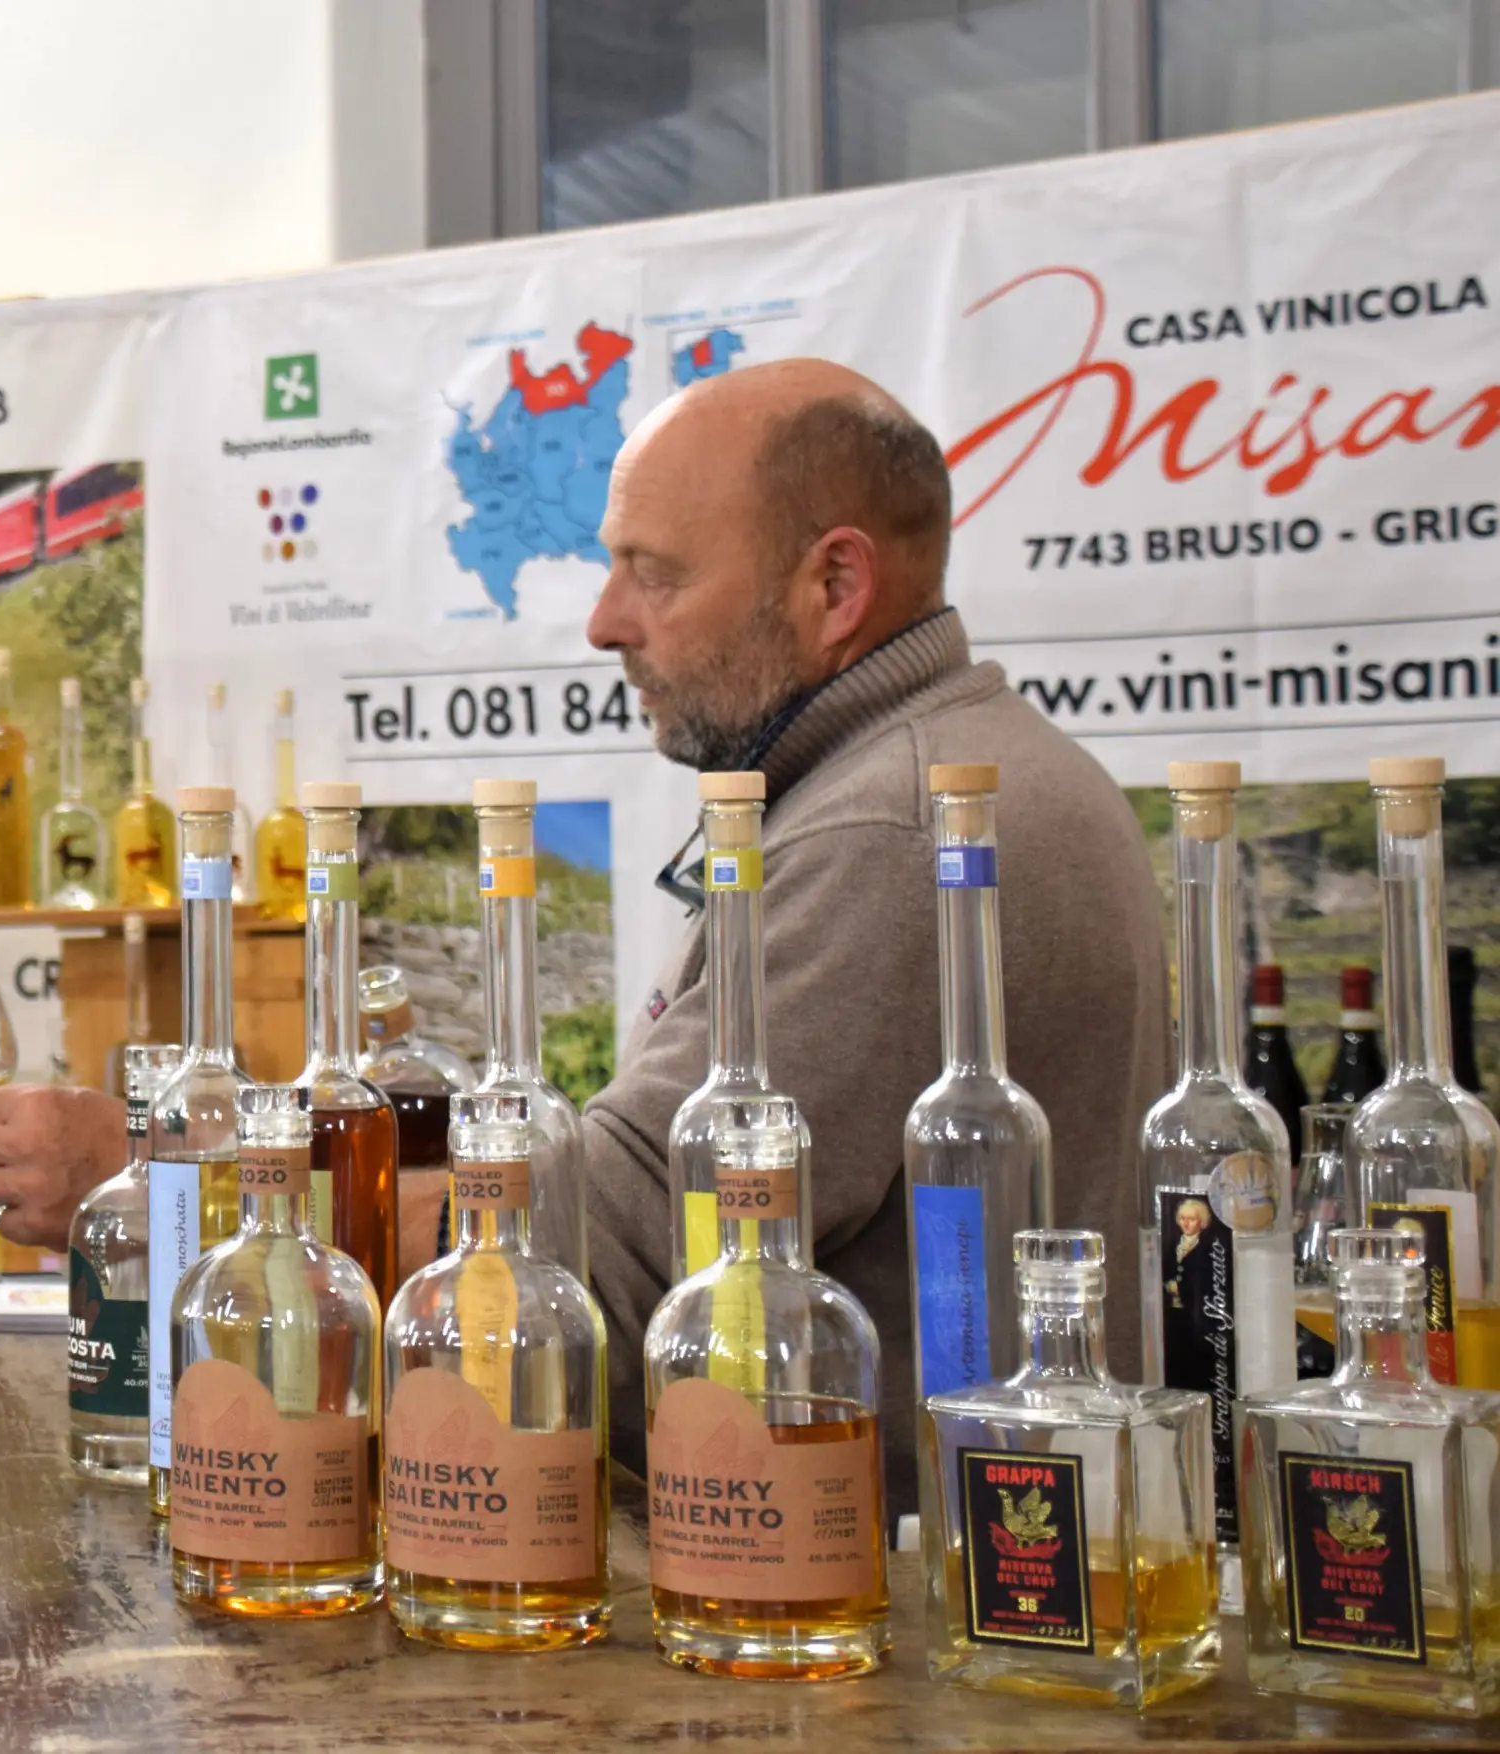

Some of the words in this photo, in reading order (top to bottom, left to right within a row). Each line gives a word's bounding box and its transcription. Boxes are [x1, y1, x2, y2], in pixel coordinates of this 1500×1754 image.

[1125, 306, 1245, 349] CASA
[1257, 274, 1488, 334] VINICOLA
[1024, 531, 1129, 571] 7743
[1145, 516, 1322, 564] BRUSIO
[1372, 503, 1500, 548] GRIG
[345, 686, 430, 743] Tel.
[446, 686, 539, 740] 081
[562, 680, 653, 734] 84
[13, 955, 63, 1002] CR
[1203, 1237, 1234, 1331] Sforzato
[176, 1442, 279, 1473] WHISKY
[389, 1455, 500, 1487] WHISKY
[173, 1464, 287, 1498] SAIENTO
[653, 1469, 774, 1502] WHISKY
[985, 1464, 1056, 1488] GRAPPA
[1310, 1469, 1381, 1494] KIRSCH
[215, 1502, 266, 1515] BARREL
[387, 1480, 508, 1514] SAIENTO
[652, 1497, 783, 1530] SAIENTO
[432, 1516, 485, 1531] BARREL
[702, 1534, 760, 1549] BARREL
